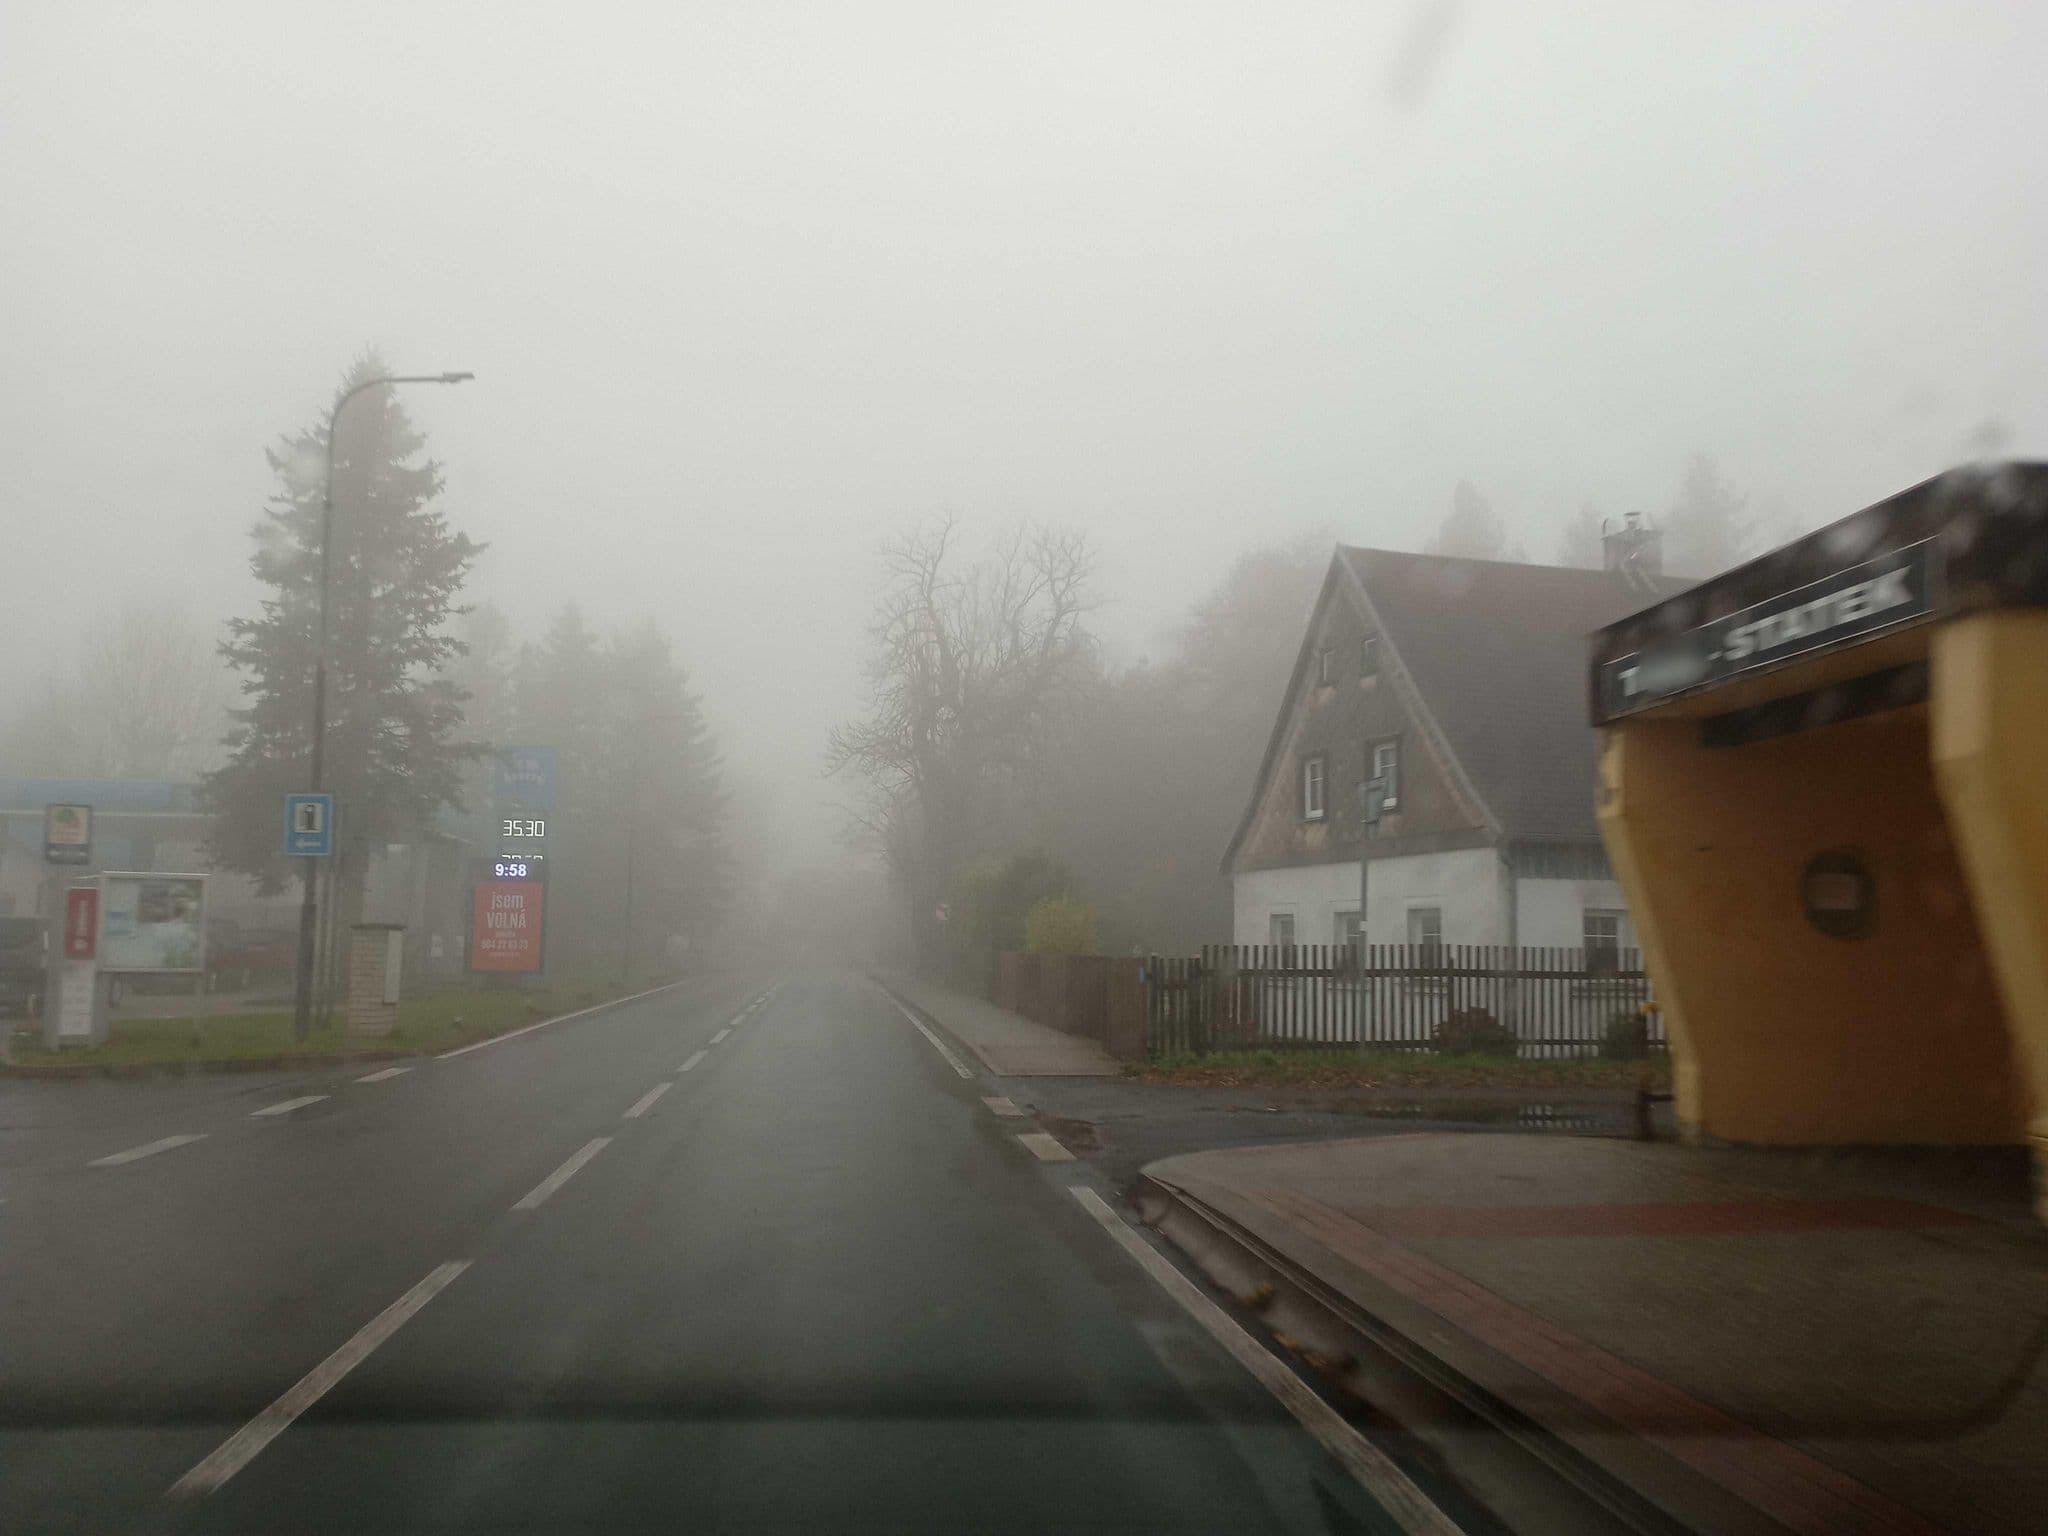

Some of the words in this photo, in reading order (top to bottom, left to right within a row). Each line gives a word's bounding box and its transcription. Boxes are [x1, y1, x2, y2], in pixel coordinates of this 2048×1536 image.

[495, 863, 527, 877] 9:58
[491, 891, 524, 910] jsem
[487, 909, 527, 929] VOLNÁ
